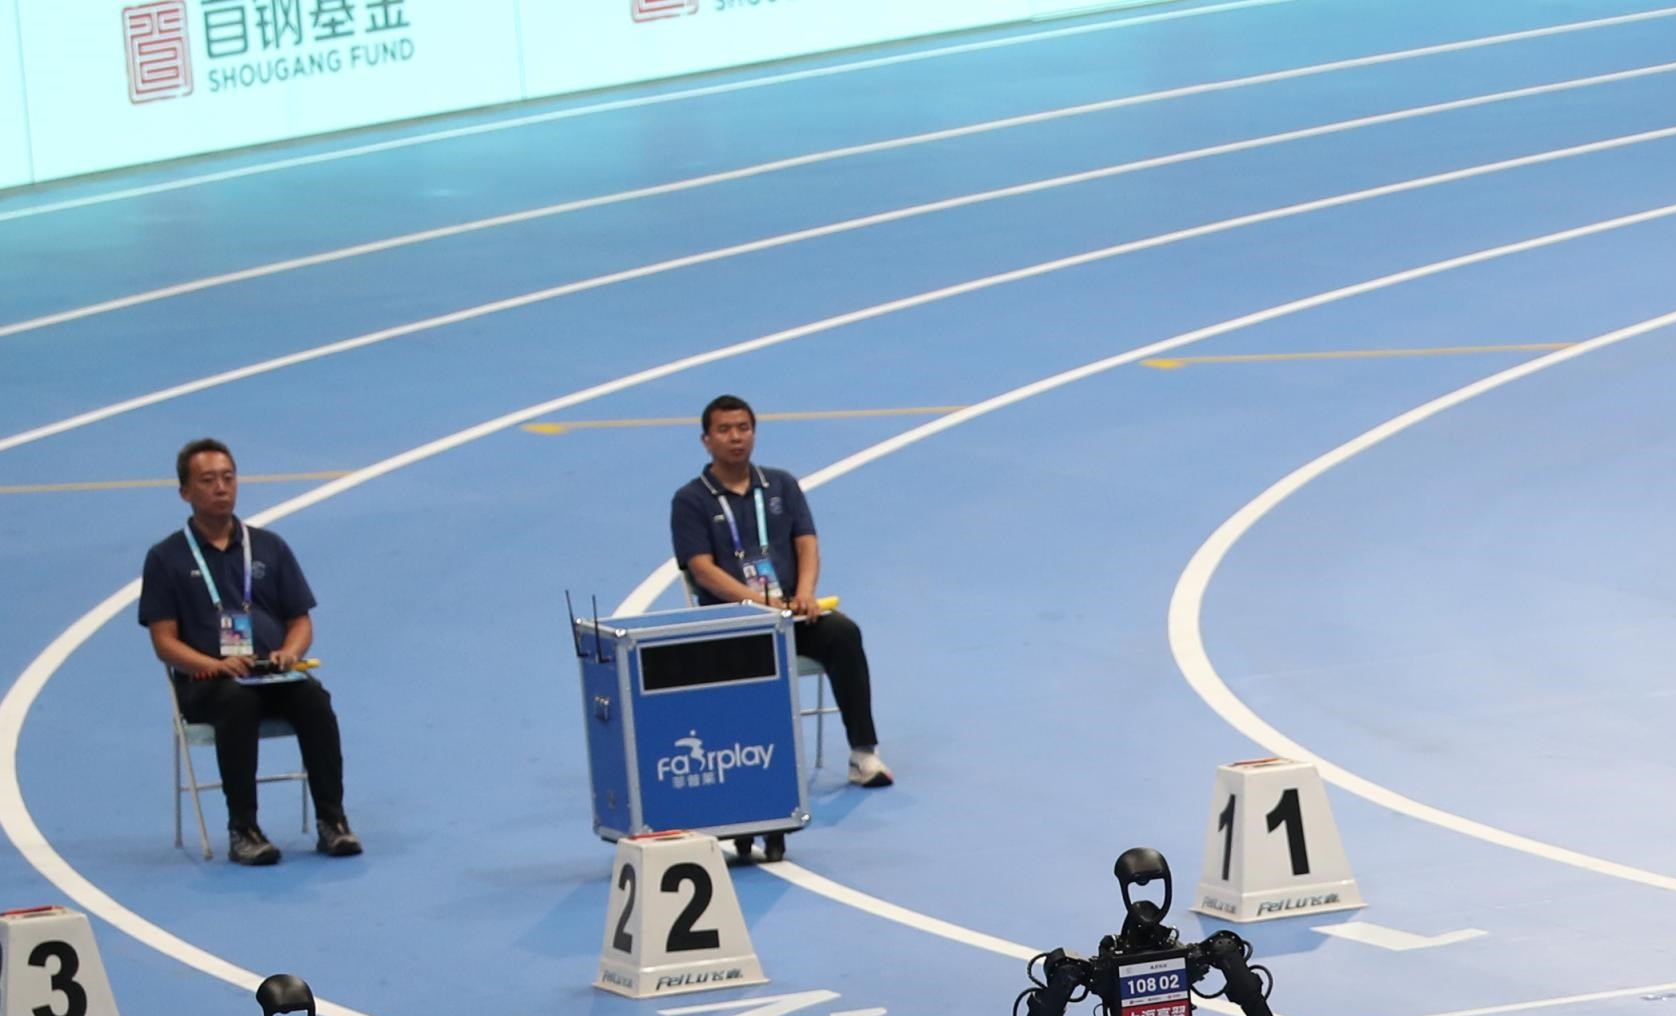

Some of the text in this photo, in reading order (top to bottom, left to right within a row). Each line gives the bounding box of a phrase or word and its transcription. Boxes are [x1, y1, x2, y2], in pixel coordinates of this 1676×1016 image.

[208, 38, 415, 93] SHOUGANG FUND
[1217, 793, 1236, 881] 1
[1265, 788, 1311, 876] 1
[612, 862, 637, 955] 2
[660, 862, 721, 953] 2
[1127, 974, 1180, 994] 108 02
